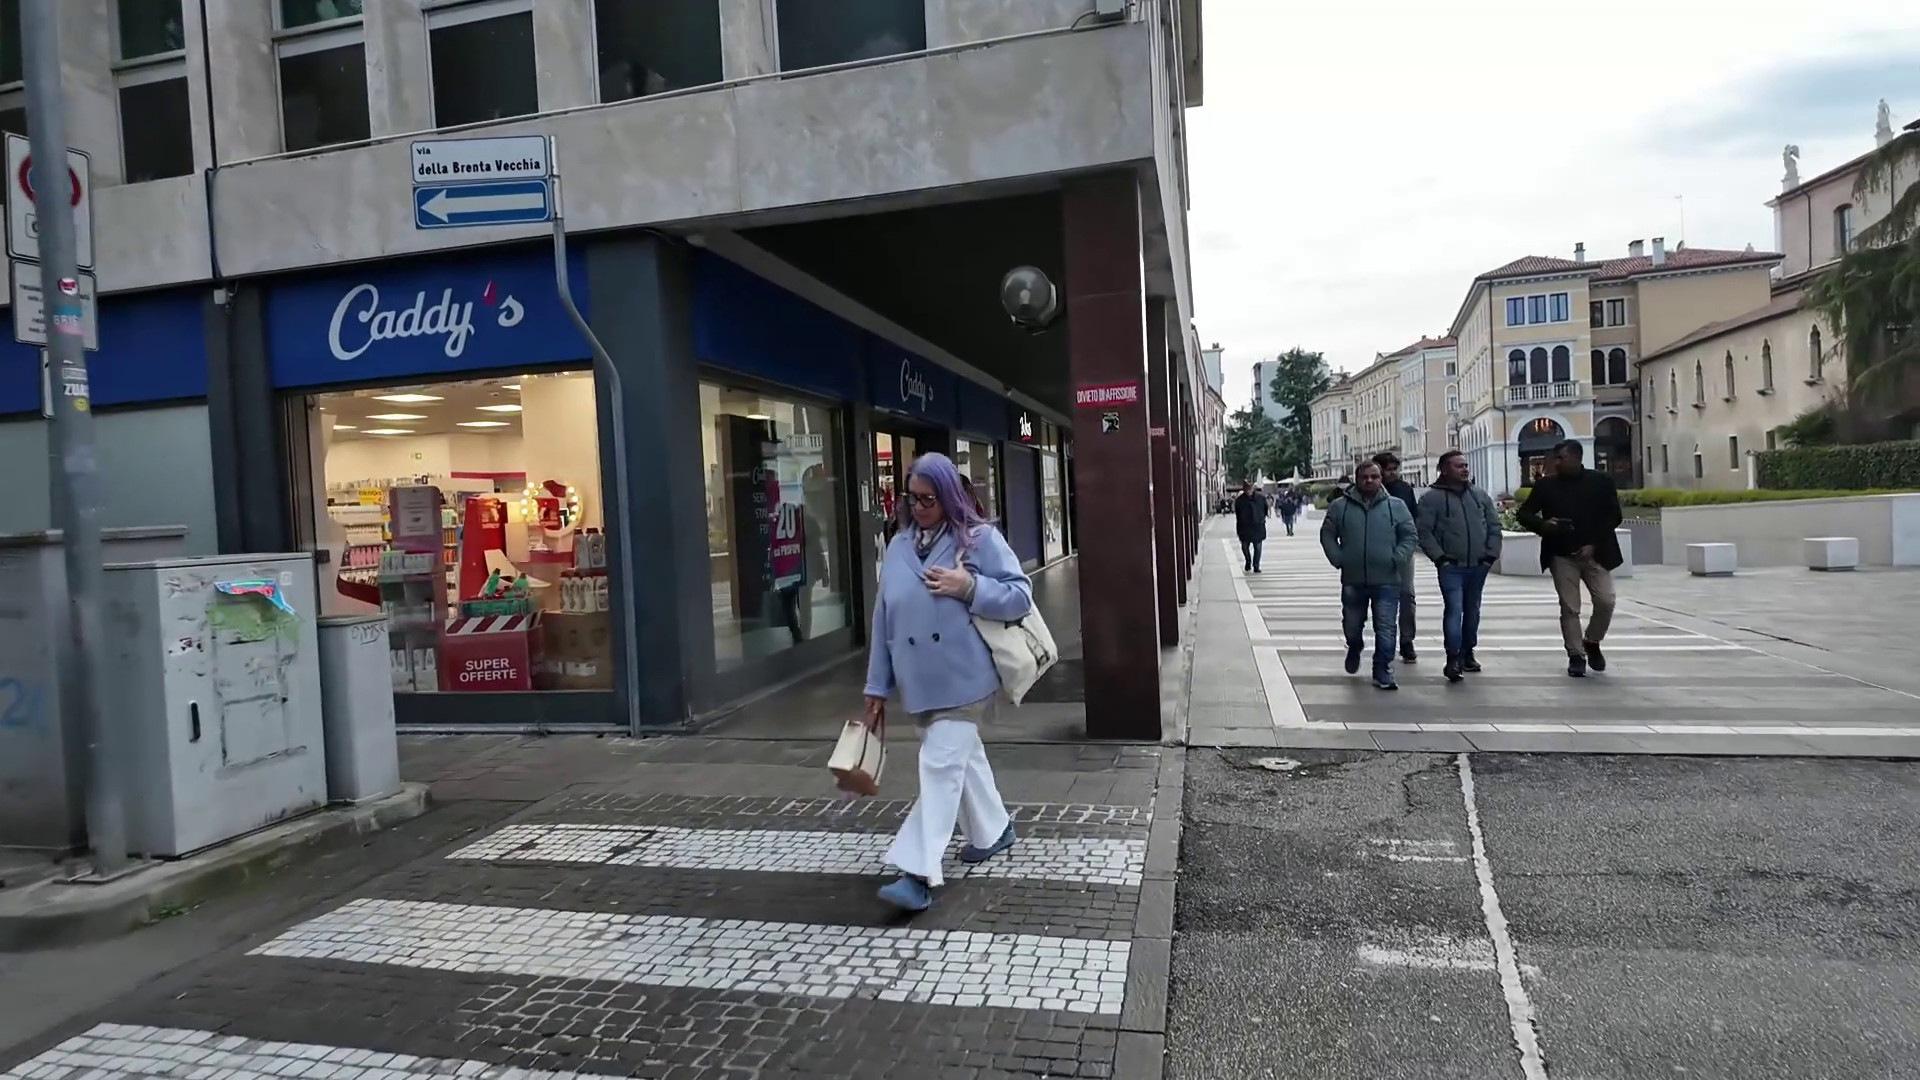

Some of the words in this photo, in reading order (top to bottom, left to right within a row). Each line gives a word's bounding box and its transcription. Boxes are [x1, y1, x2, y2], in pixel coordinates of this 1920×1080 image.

[416, 146, 431, 155] via
[418, 163, 448, 175] della
[453, 161, 492, 173] Brenta
[495, 159, 541, 171] Vecchia
[329, 281, 525, 361] Caddy's
[900, 358, 934, 412] Caddys
[1077, 390, 1098, 403] DIVIETO
[1099, 388, 1105, 402] DI
[1105, 386, 1137, 401] AFFISSIONE
[465, 658, 509, 671] SUPER
[459, 668, 517, 682] OFFERTE
